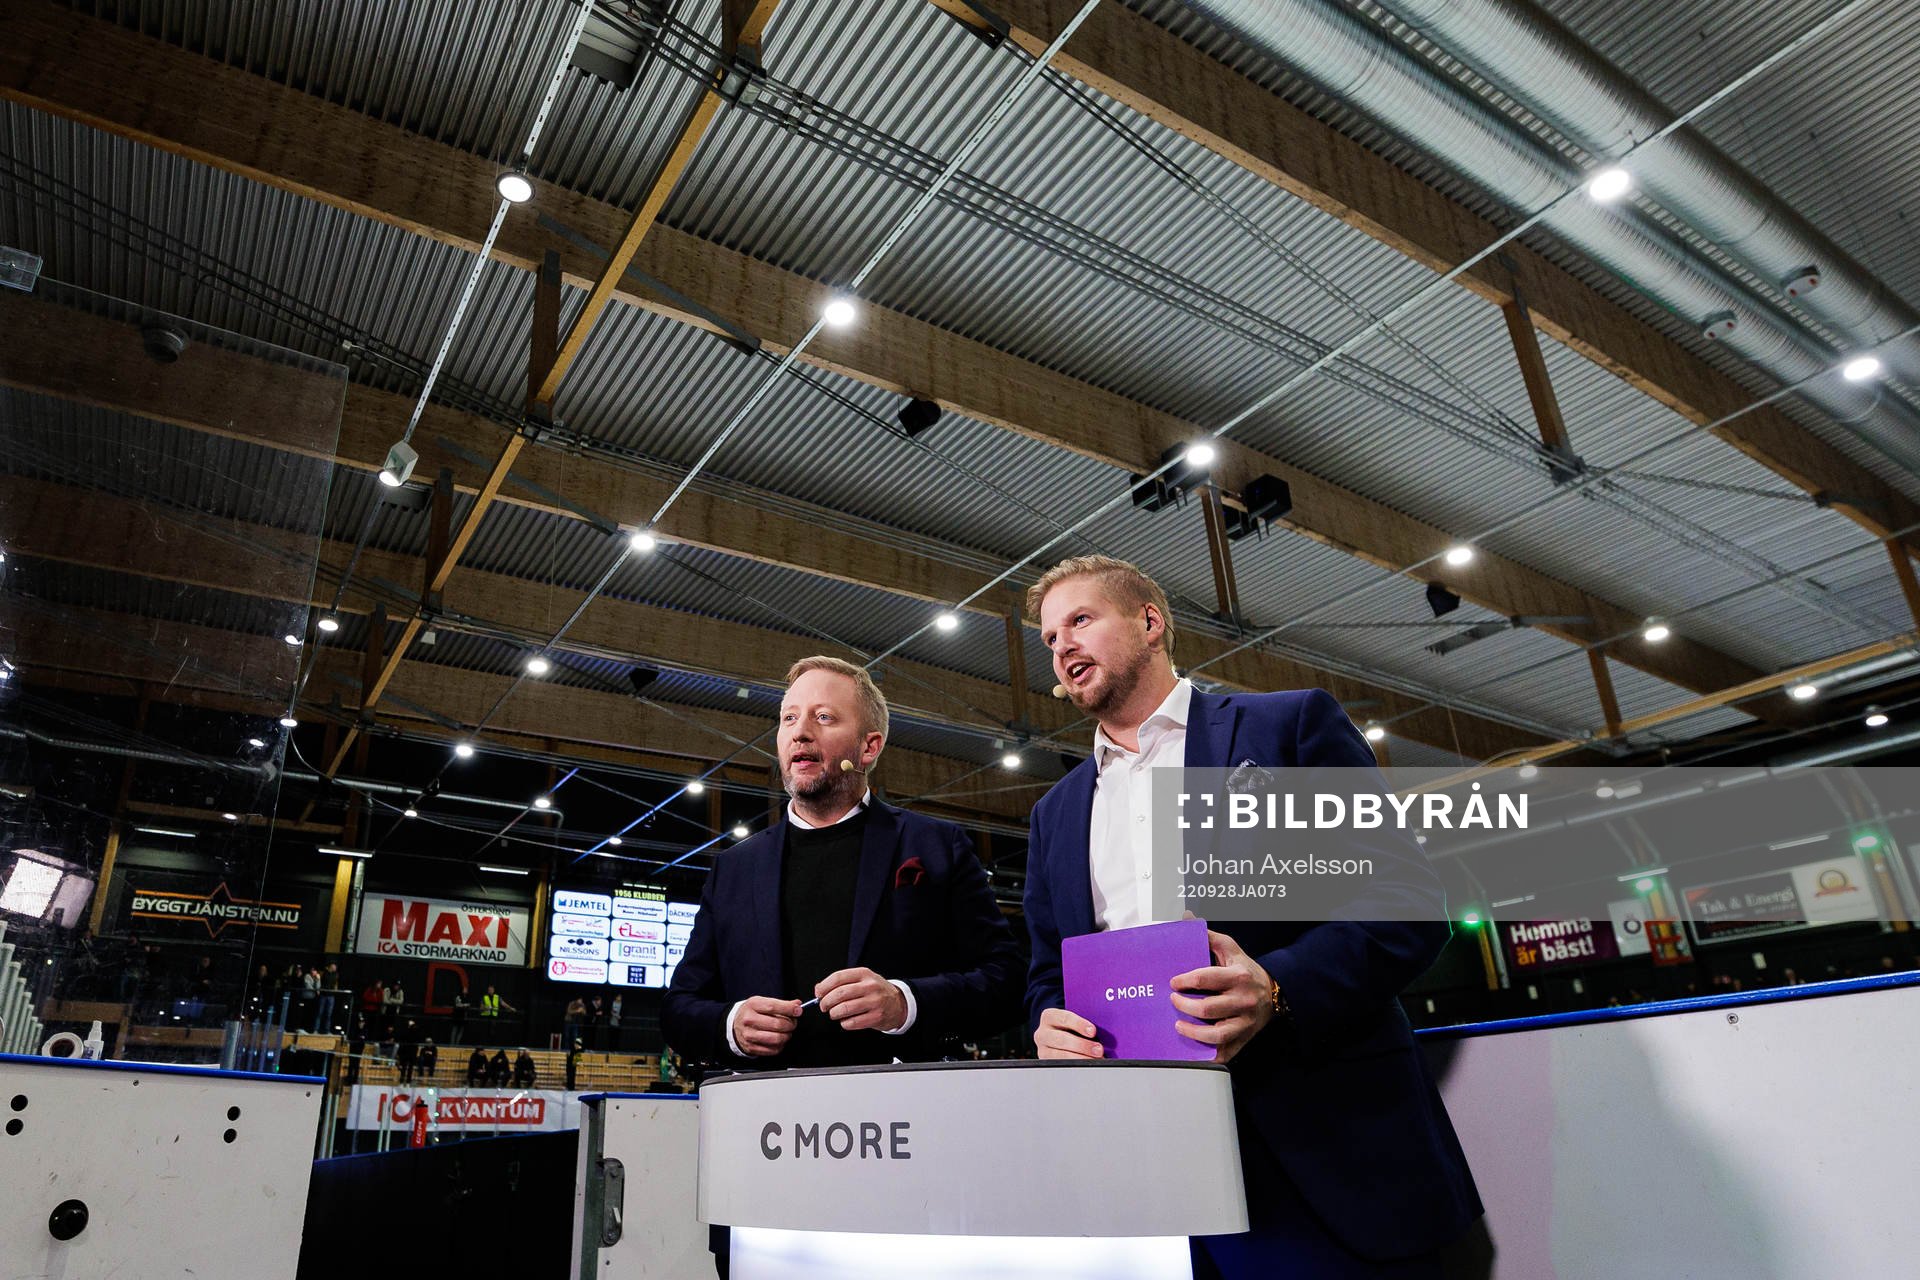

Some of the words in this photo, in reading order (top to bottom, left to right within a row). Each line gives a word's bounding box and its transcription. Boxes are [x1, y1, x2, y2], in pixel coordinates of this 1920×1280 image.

[131, 897, 299, 923] BYGGTJÄNSTEN.NU
[568, 899, 608, 911] JEMTEL
[379, 898, 510, 949] MAXI
[1510, 917, 1593, 944] Hemma
[377, 942, 399, 954] ICA
[402, 943, 507, 962] STORMARKNAD
[559, 946, 600, 956] NILSSONS
[623, 944, 657, 957] granit
[1516, 946, 1537, 965] är
[1540, 935, 1595, 962] bäst!
[1117, 984, 1154, 999] MORE
[440, 1102, 541, 1119] KVANTUM
[795, 1122, 911, 1160] MORE
